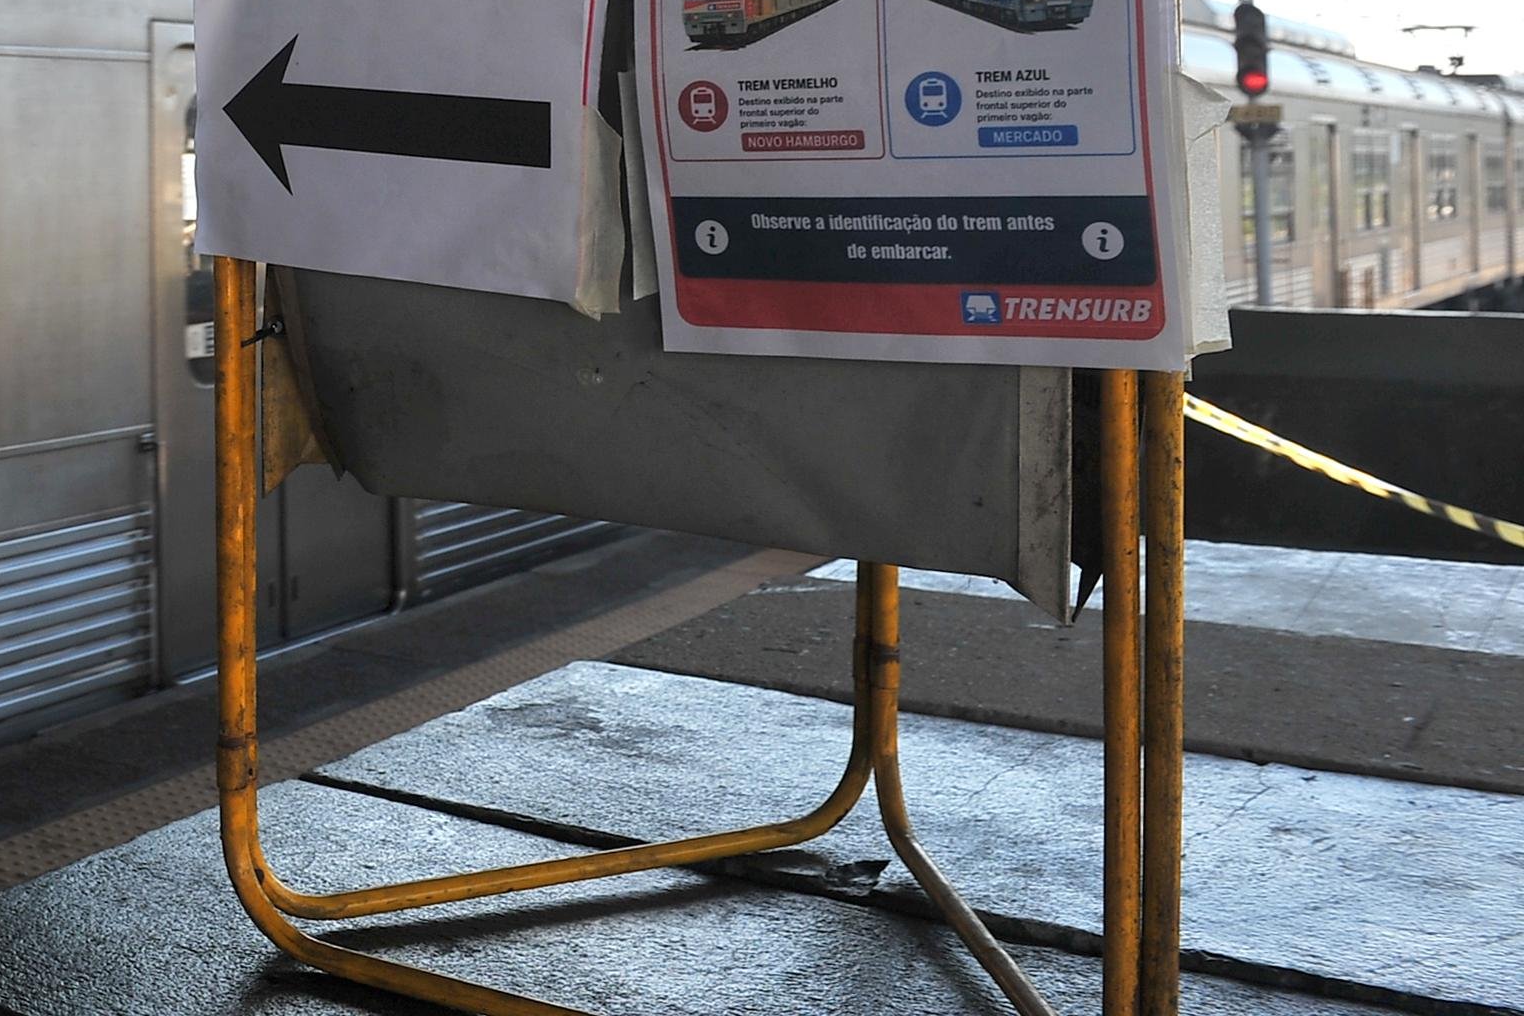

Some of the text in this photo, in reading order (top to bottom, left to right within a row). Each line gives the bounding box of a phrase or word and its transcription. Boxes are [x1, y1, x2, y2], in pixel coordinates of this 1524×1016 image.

[975, 69, 1051, 83] TREM AZUL
[737, 77, 838, 92] TREM VERMELHO
[976, 86, 1094, 99] Destino exibido na parte
[738, 95, 844, 106] Destino exibido na parte
[976, 99, 1067, 112] frontal superior do
[739, 107, 820, 118] frontal superior do
[977, 112, 1053, 124] primeiro vagão:
[740, 119, 776, 129] primeiro
[747, 134, 857, 148] NOVO HAMBURGO
[992, 129, 1063, 144] MERCADO
[750, 212, 1055, 234] Observe a identificação do trem antes
[847, 242, 953, 260] de embarcar.
[1003, 295, 1154, 323] TRENSURB
